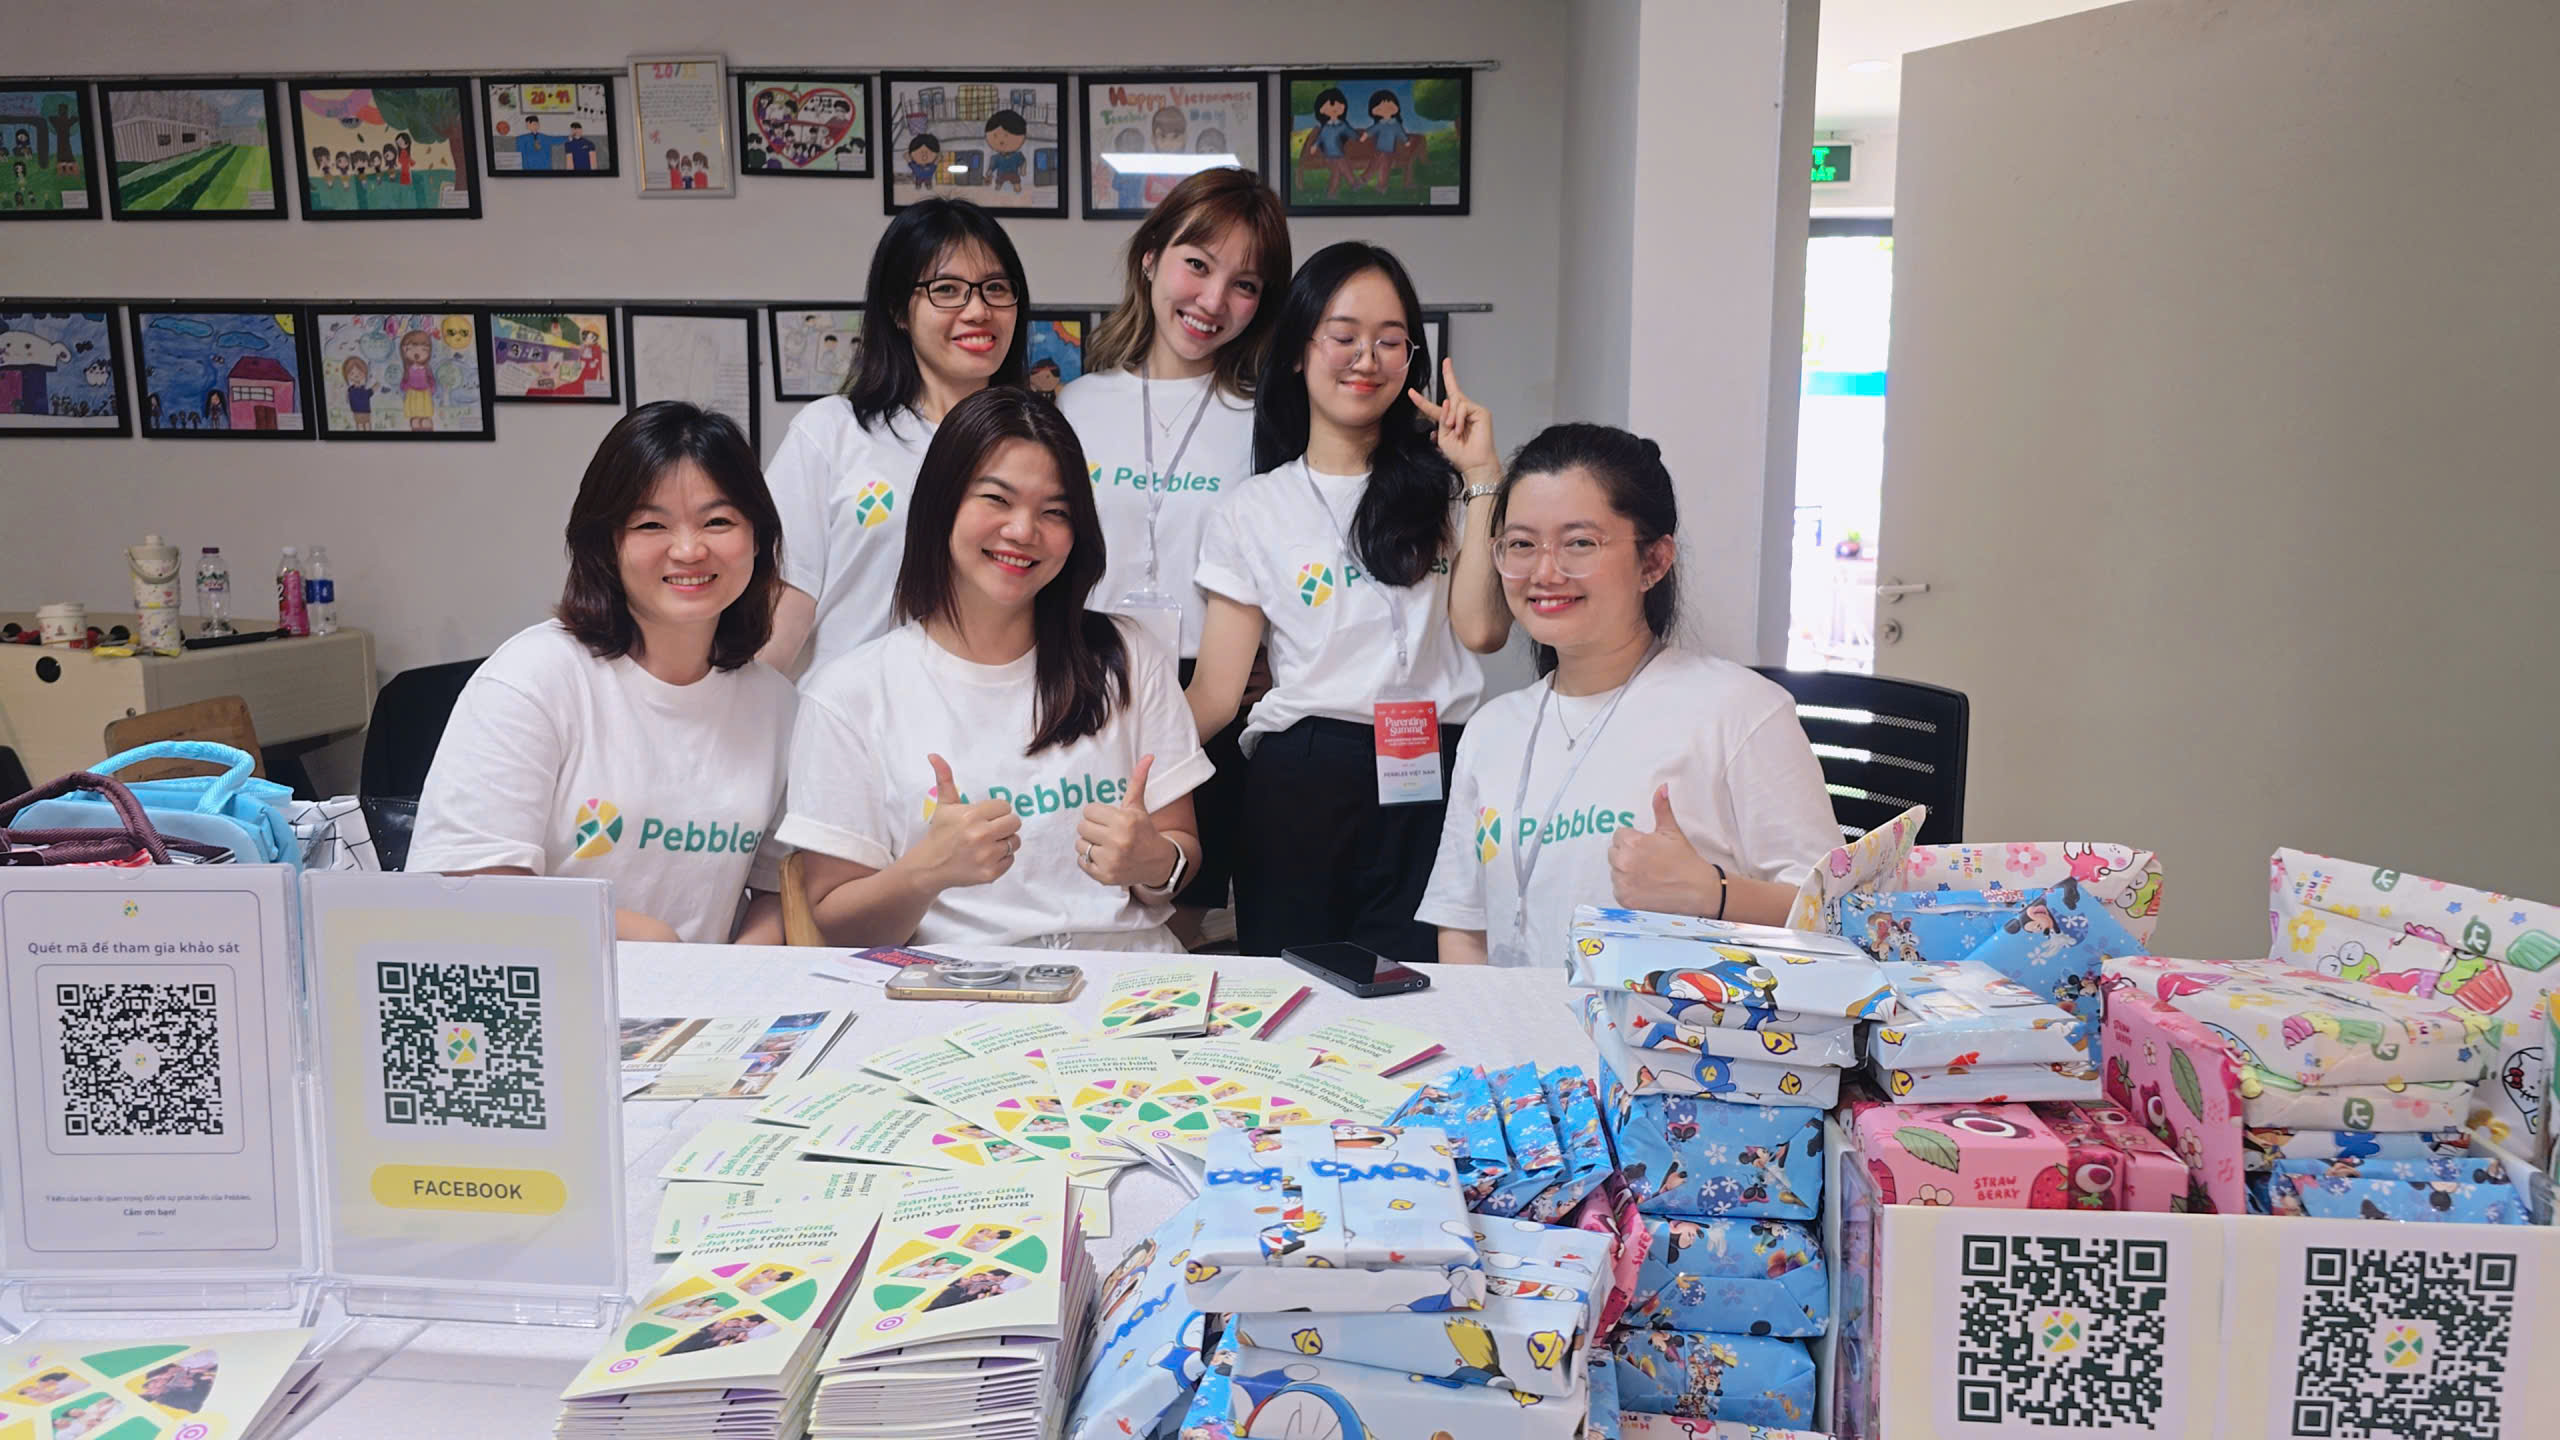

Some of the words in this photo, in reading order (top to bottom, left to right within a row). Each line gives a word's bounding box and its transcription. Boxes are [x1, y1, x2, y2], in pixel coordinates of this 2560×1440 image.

[28, 942, 62, 955] Quét
[66, 942, 88, 953] mã
[113, 942, 150, 953] tham
[154, 943, 175, 956] gia
[179, 940, 214, 953] khảo
[218, 941, 240, 953] sát
[413, 1179, 523, 1200] FACEBOOK
[1973, 1176, 2017, 1191] STRAW
[1977, 1187, 2021, 1202] BERRY
